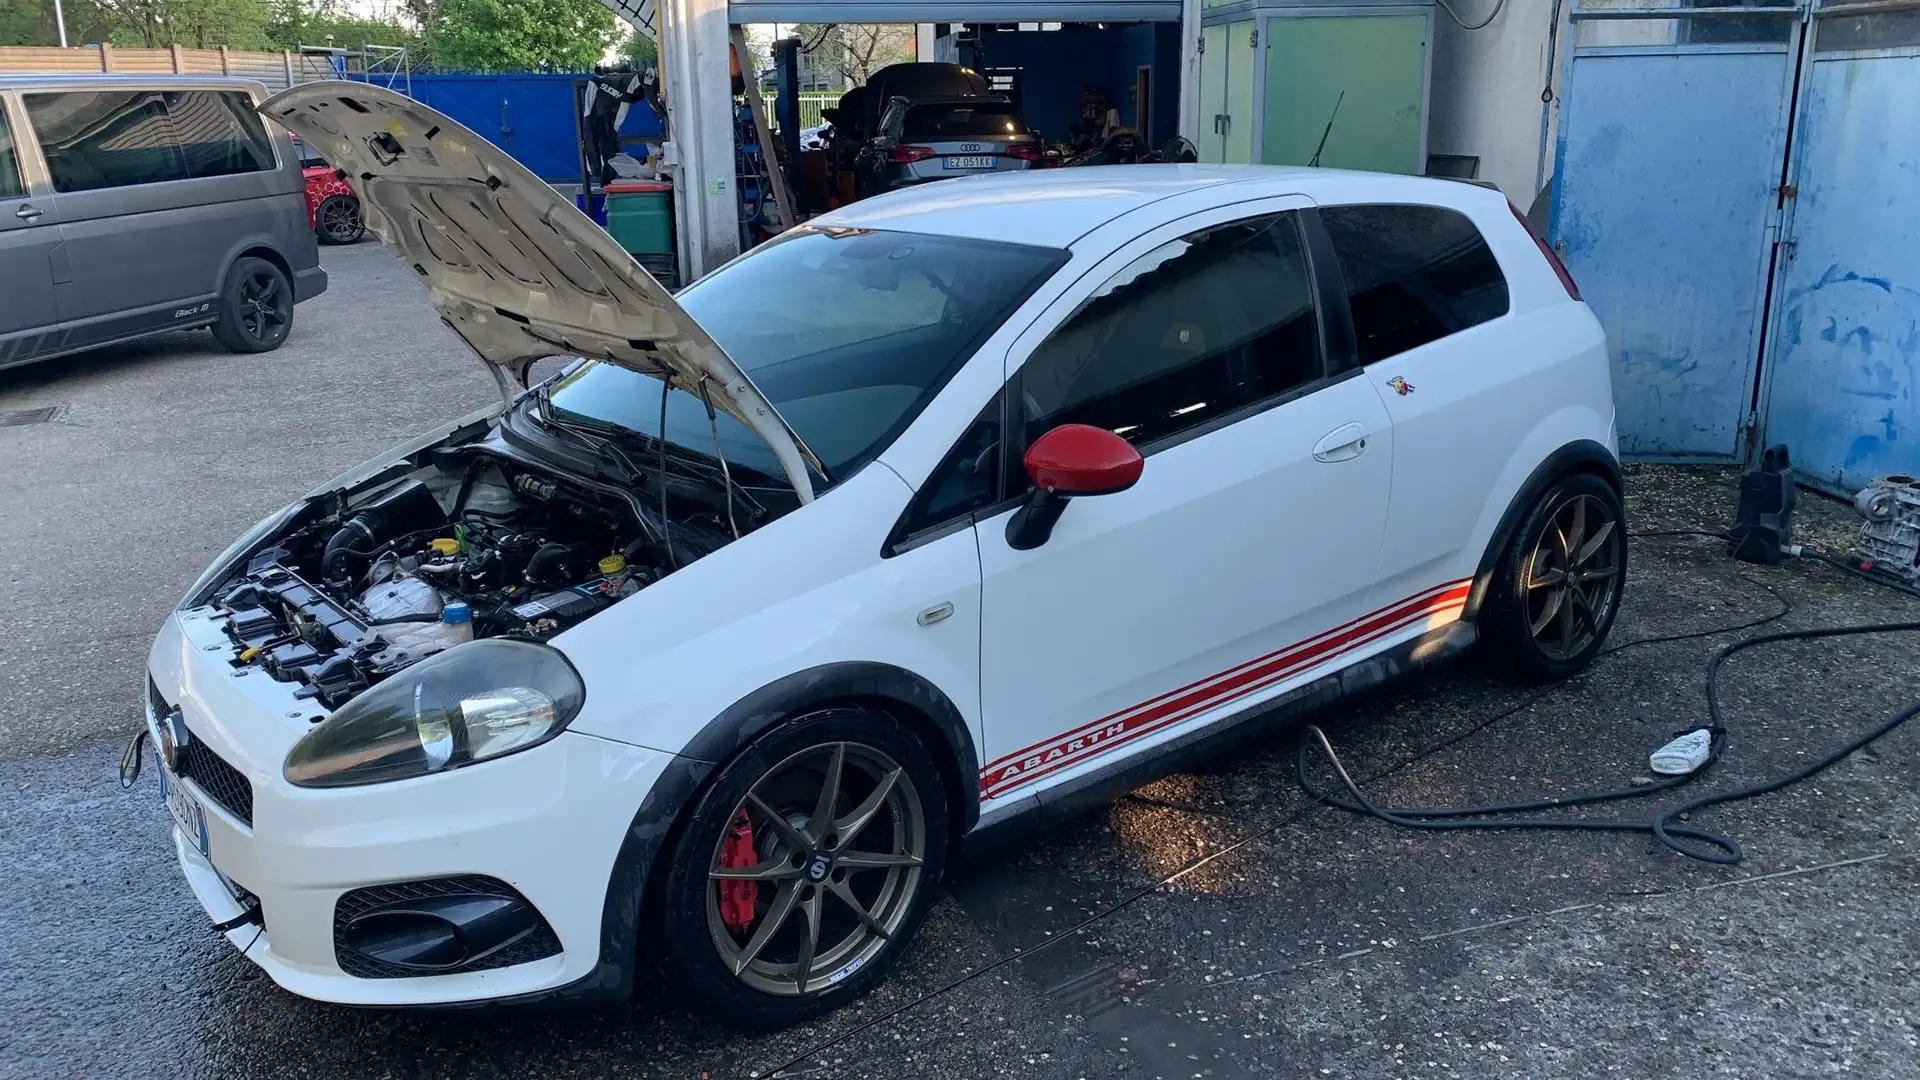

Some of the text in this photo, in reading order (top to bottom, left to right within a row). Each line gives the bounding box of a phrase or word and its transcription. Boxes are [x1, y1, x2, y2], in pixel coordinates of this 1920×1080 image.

[949, 156, 992, 167] EZ 051KK
[175, 306, 199, 318] Black
[1000, 722, 1124, 780] ABARTH
